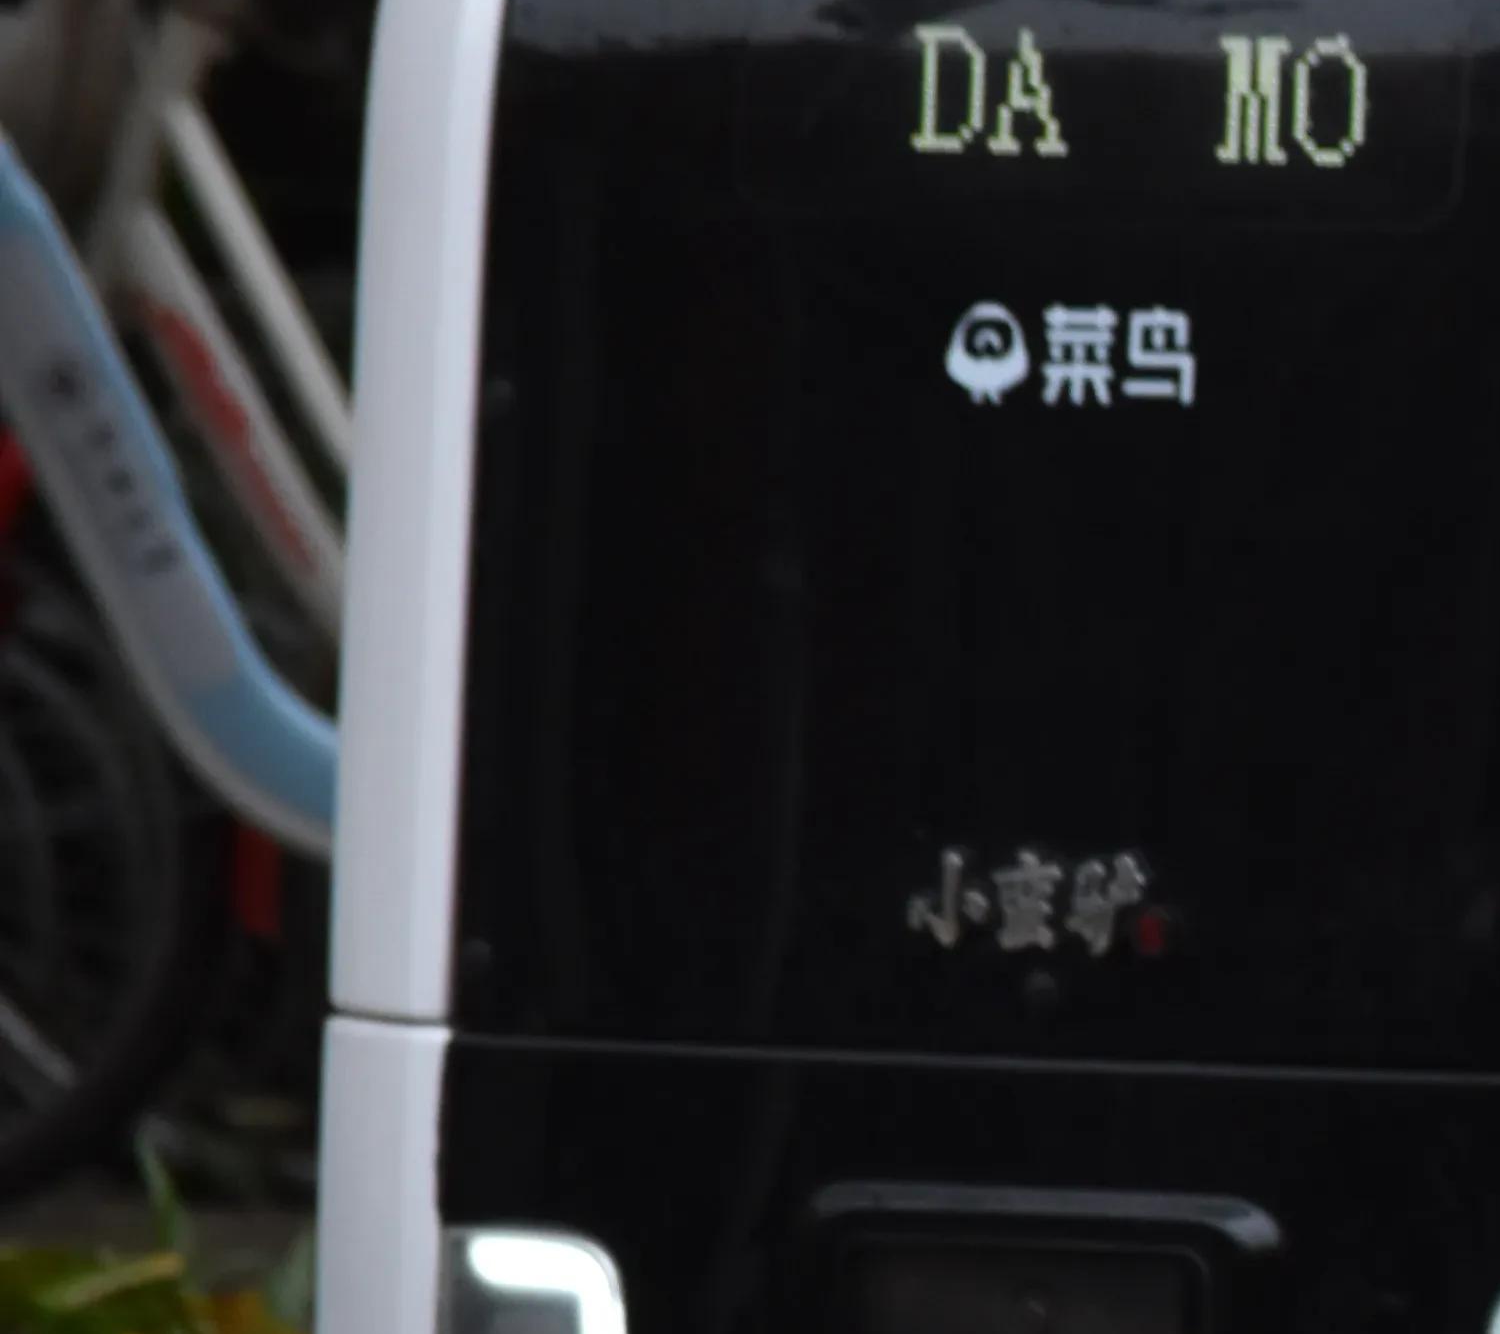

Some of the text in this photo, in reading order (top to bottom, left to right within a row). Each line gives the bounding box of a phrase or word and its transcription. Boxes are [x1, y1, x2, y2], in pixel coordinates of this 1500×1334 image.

[911, 23, 1368, 167] DA MO
[1042, 304, 1196, 406] 菜鸟
